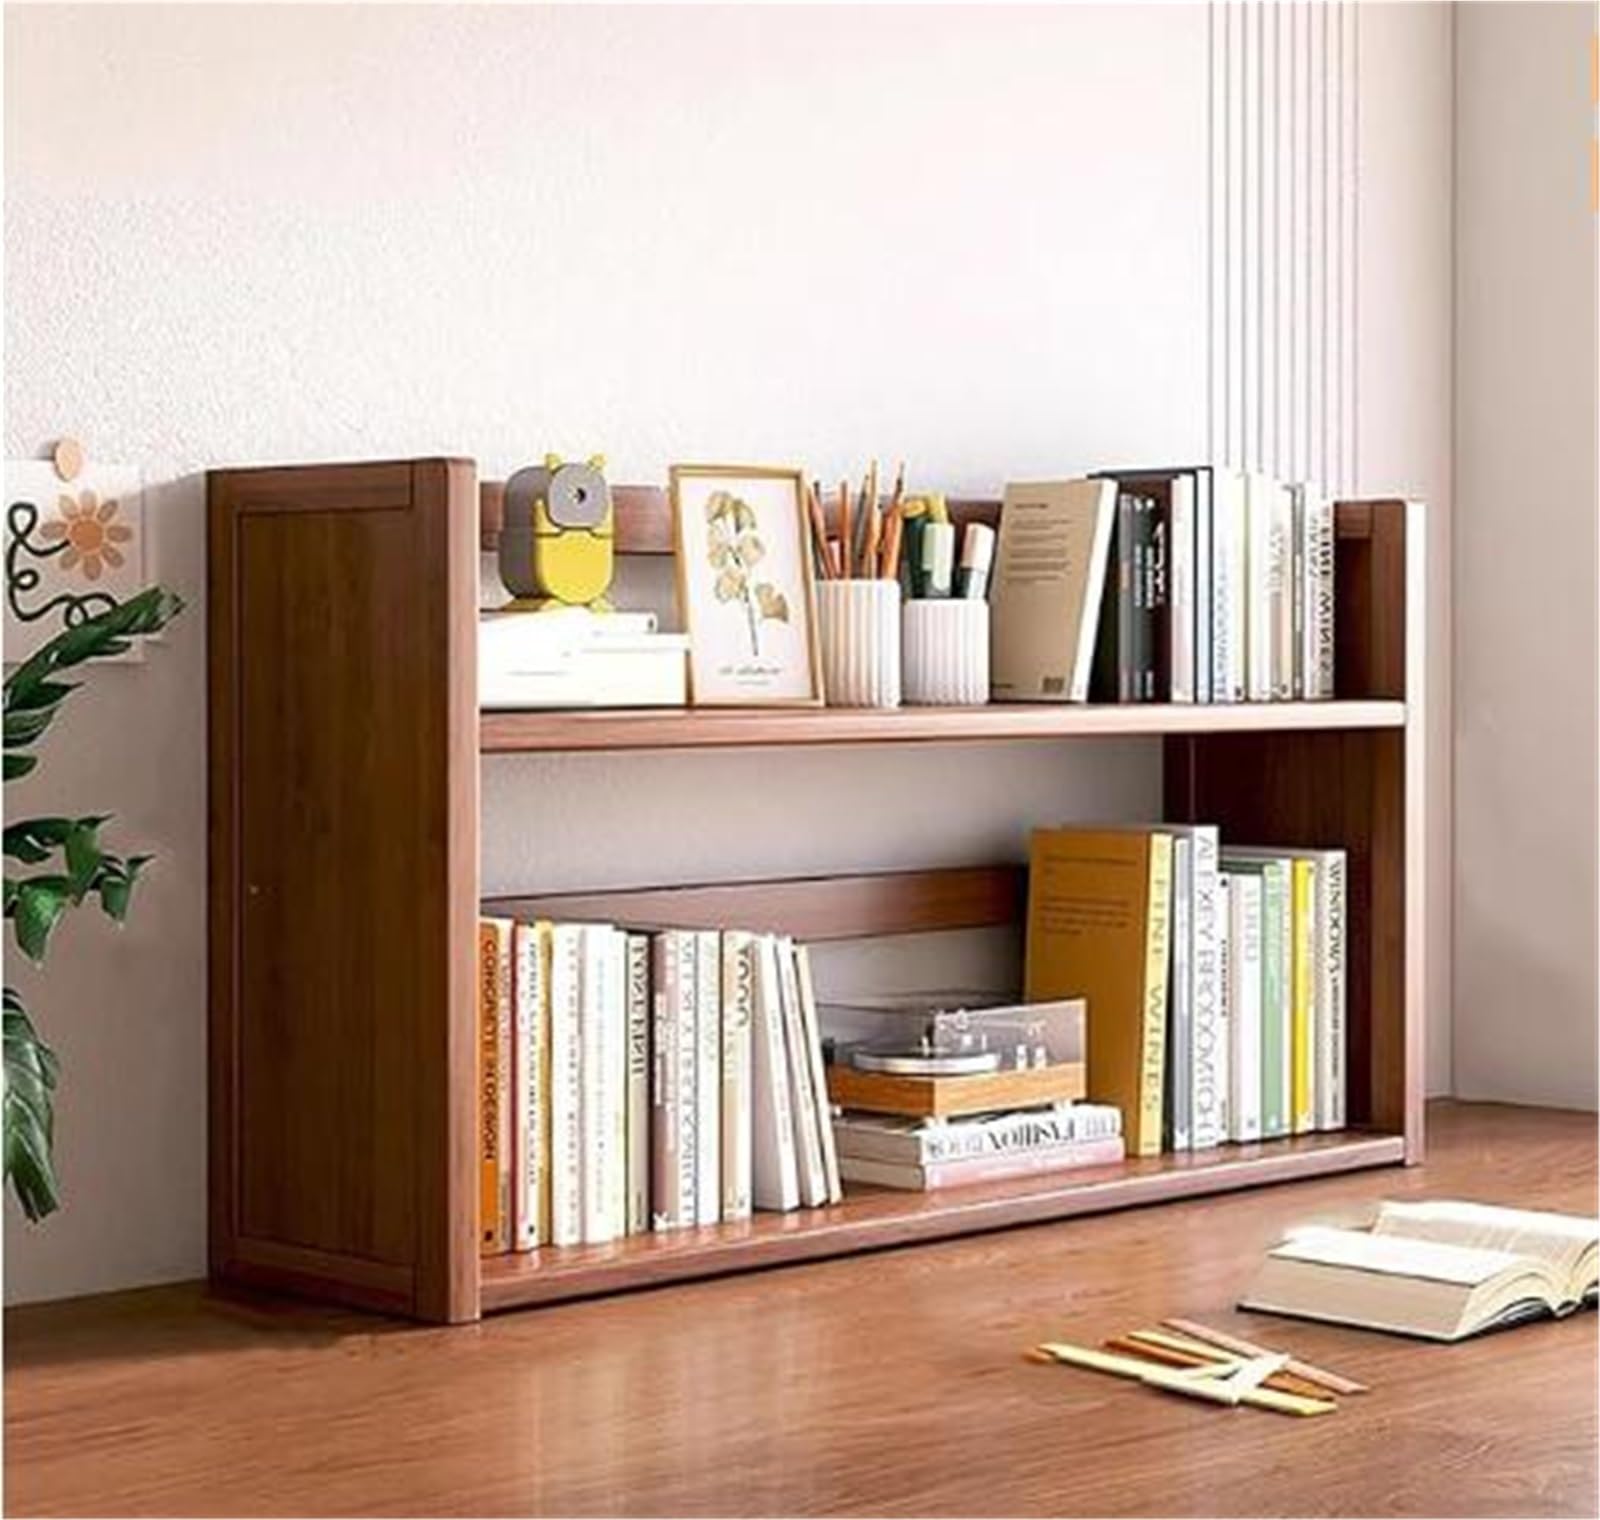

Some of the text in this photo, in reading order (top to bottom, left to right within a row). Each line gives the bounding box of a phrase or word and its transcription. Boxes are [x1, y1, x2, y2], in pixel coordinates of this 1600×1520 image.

[1327, 860, 1342, 973] WINDOWS
[481, 939, 497, 1055] CONCRETE
[1145, 984, 1163, 1111] WINES
[481, 1081, 496, 1160] DESIGN
